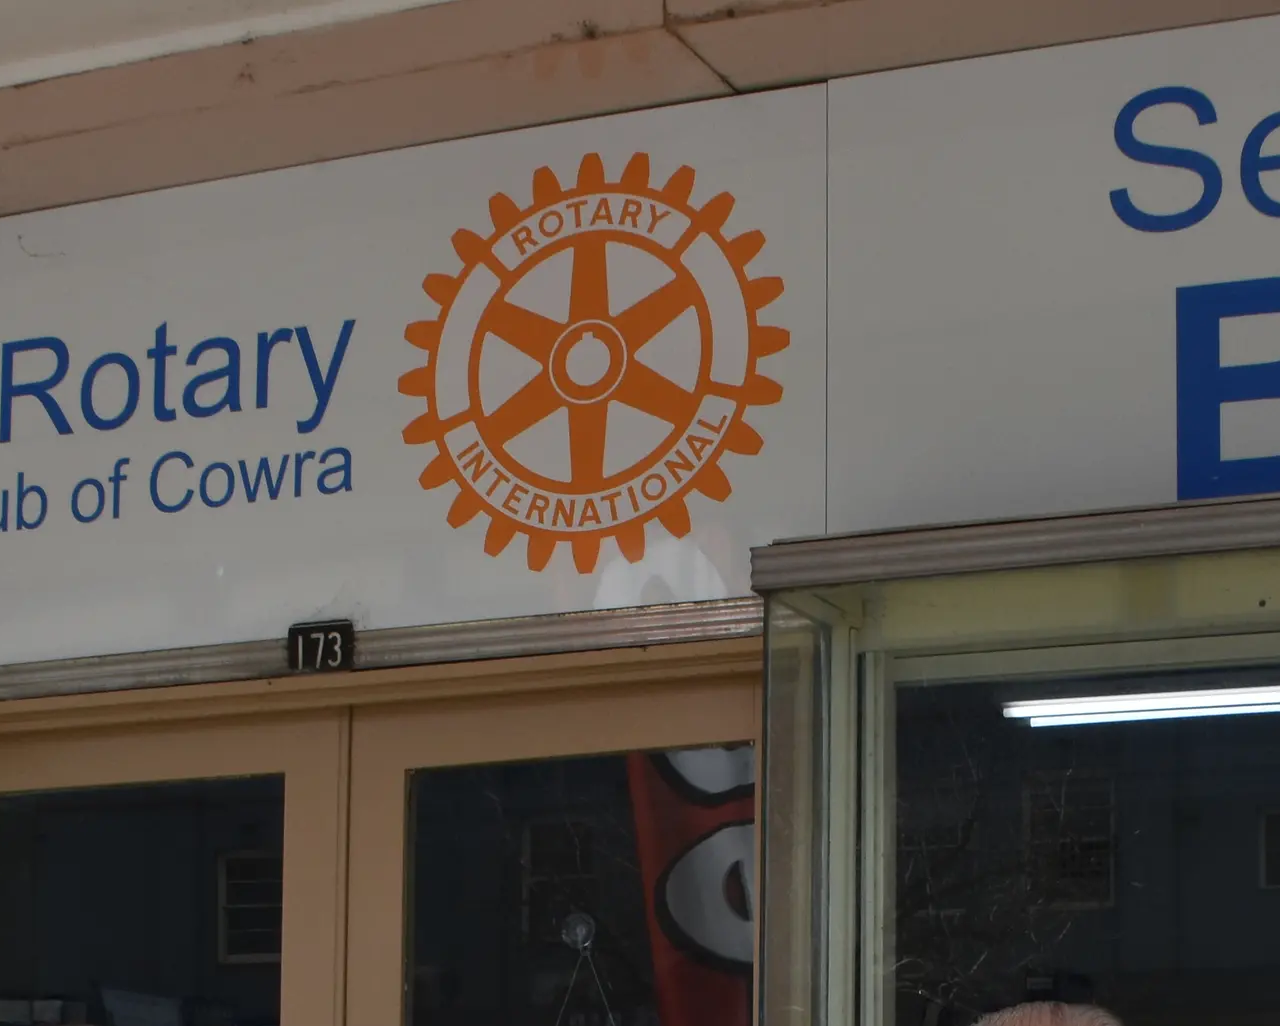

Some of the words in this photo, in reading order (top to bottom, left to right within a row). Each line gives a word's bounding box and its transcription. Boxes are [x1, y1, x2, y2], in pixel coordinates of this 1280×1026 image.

[511, 197, 671, 257] ROTARY
[71, 457, 129, 522] of
[148, 446, 354, 512] Cowra
[456, 414, 729, 529] INTERNATIONAL
[297, 631, 341, 665] 173
